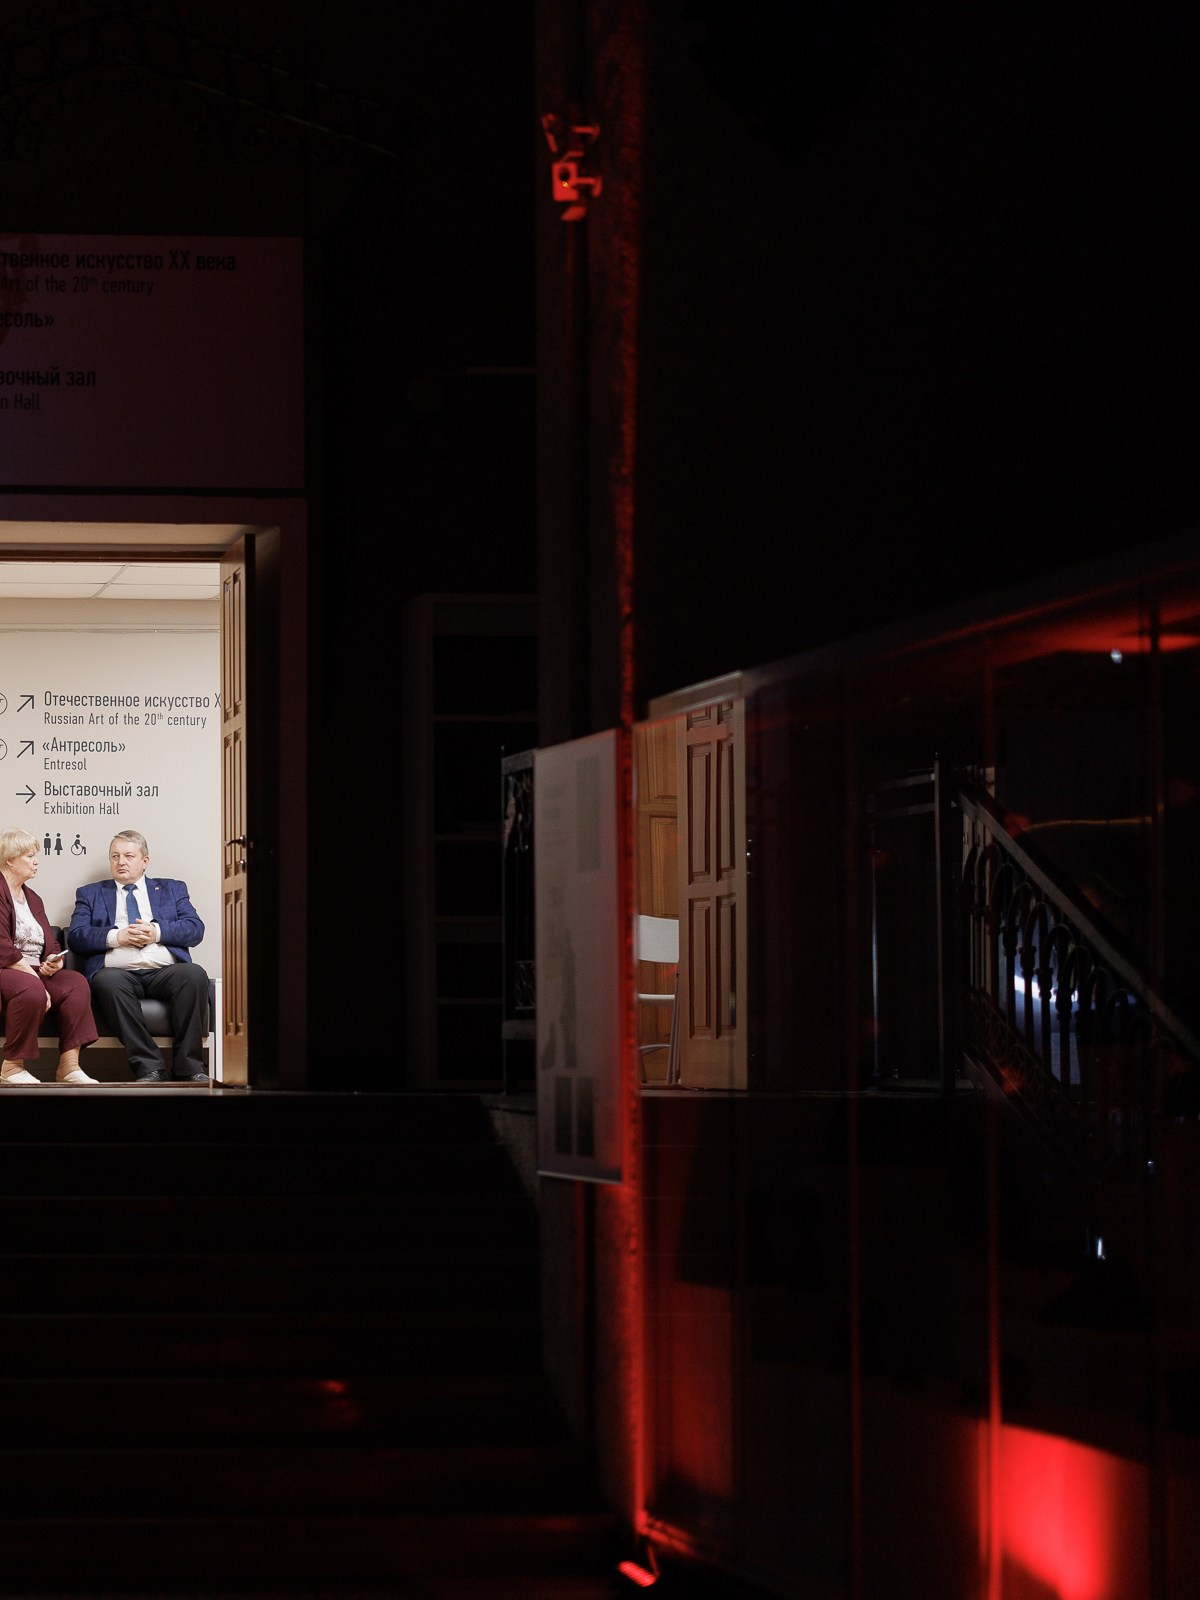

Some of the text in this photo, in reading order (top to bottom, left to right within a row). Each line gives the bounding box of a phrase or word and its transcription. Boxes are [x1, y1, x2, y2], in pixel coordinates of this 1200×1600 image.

[75, 254, 164, 275] искусство
[196, 255, 236, 271] века
[0, 276, 21, 292] Art
[26, 276, 40, 292] of
[44, 276, 66, 293] the
[102, 279, 155, 297] century
[66, 370, 96, 386] зал
[14, 393, 41, 410] Hall
[44, 691, 140, 706] Отечественное
[144, 696, 210, 711] искусство
[44, 712, 207, 729] Russian Art of the 20th century
[42, 737, 126, 755] «Антресоль»
[44, 758, 87, 771] Entresol
[44, 781, 159, 797] Выставочный зал
[44, 802, 120, 815] Exhibition Hall
